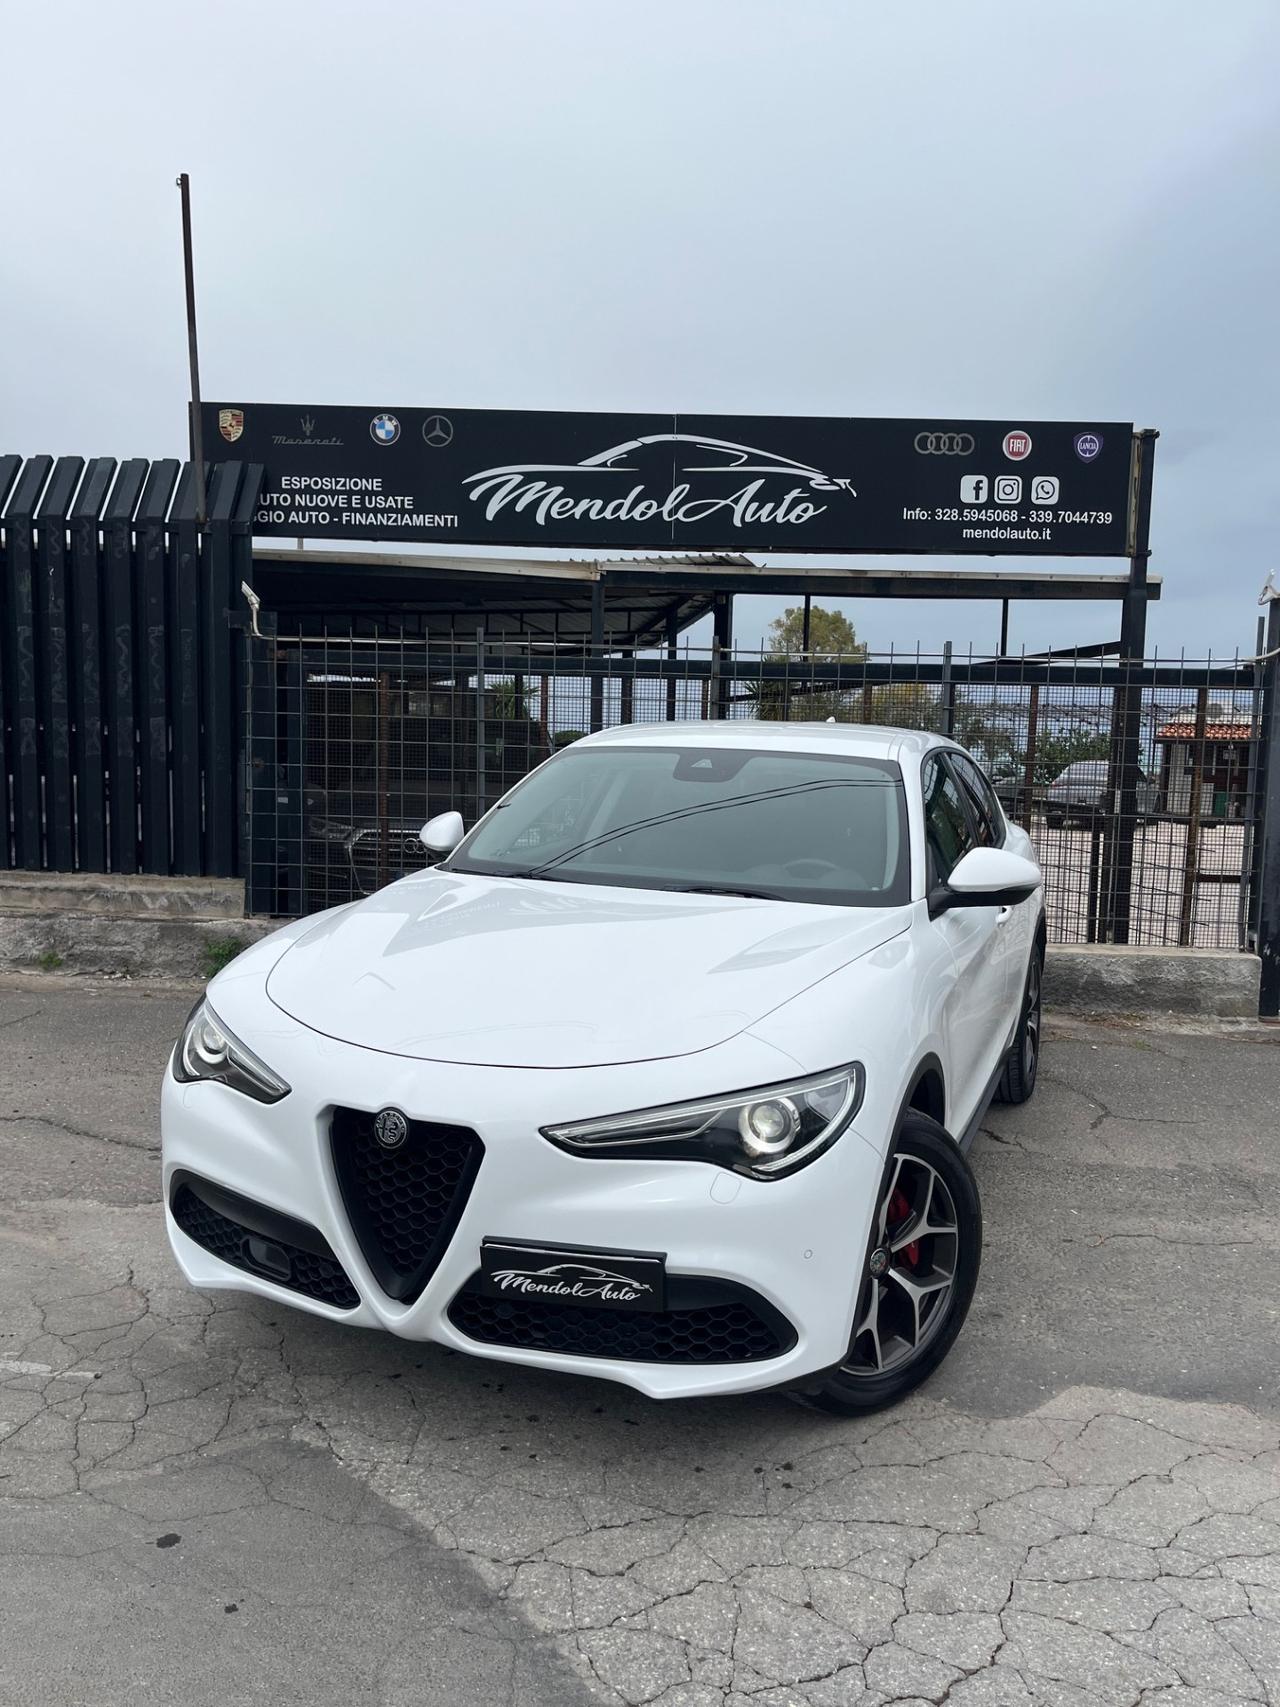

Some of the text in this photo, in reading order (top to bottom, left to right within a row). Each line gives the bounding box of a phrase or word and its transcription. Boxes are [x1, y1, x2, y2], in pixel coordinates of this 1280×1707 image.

[1009, 438, 1026, 453] FIAT
[281, 476, 383, 491] ESPOSIZIONE
[257, 493, 414, 509] UTO NUOVE E USATE
[288, 511, 331, 524] AUTO
[342, 512, 458, 528] FINANZIAMENTI
[903, 507, 932, 521] Info:
[934, 509, 1018, 523] 328.5945068
[1029, 510, 1113, 525] 339.7044739
[962, 527, 1052, 540] mendolauto.it
